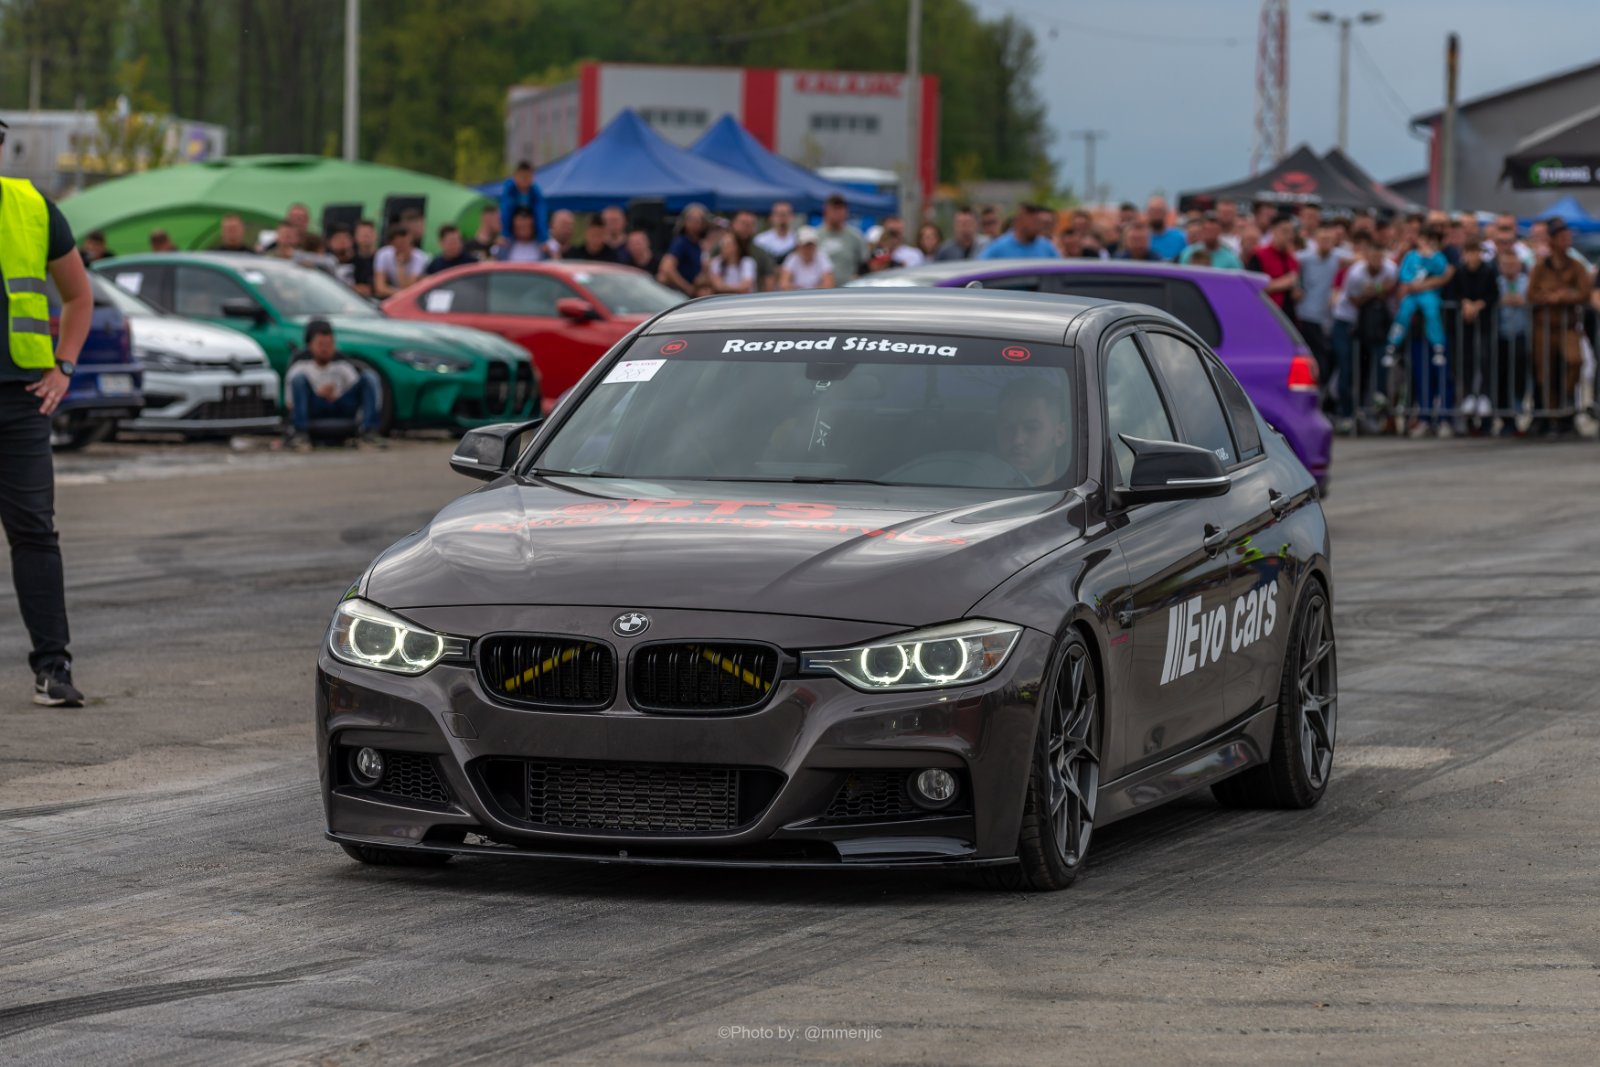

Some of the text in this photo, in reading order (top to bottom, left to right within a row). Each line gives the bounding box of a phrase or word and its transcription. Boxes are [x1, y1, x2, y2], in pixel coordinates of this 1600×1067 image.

[722, 336, 958, 357] Raspad Sistema
[622, 498, 838, 519] PTS
[626, 514, 773, 529] Tuning
[1231, 580, 1278, 653] cars
